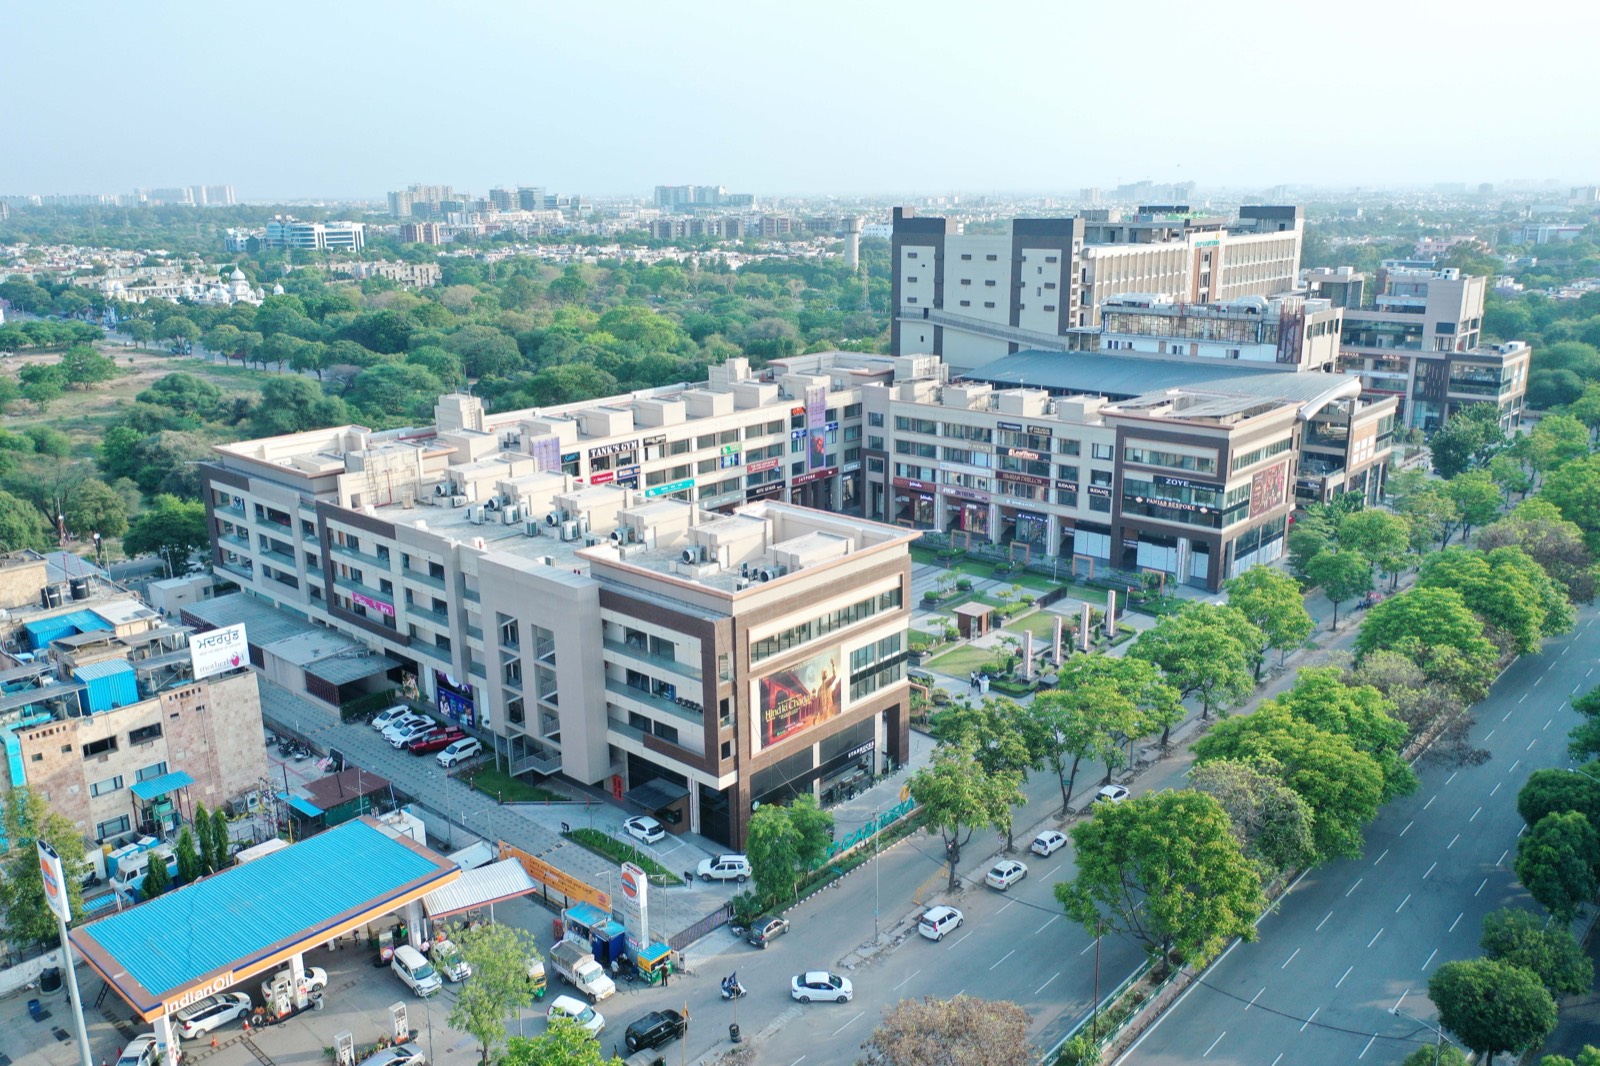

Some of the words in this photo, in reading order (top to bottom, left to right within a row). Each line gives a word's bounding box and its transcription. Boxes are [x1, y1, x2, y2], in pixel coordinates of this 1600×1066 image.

[590, 444, 620, 458] TANK'S
[620, 441, 638, 452] GYM
[1166, 478, 1189, 488] ZOYE
[164, 973, 234, 1015] IndianOil
